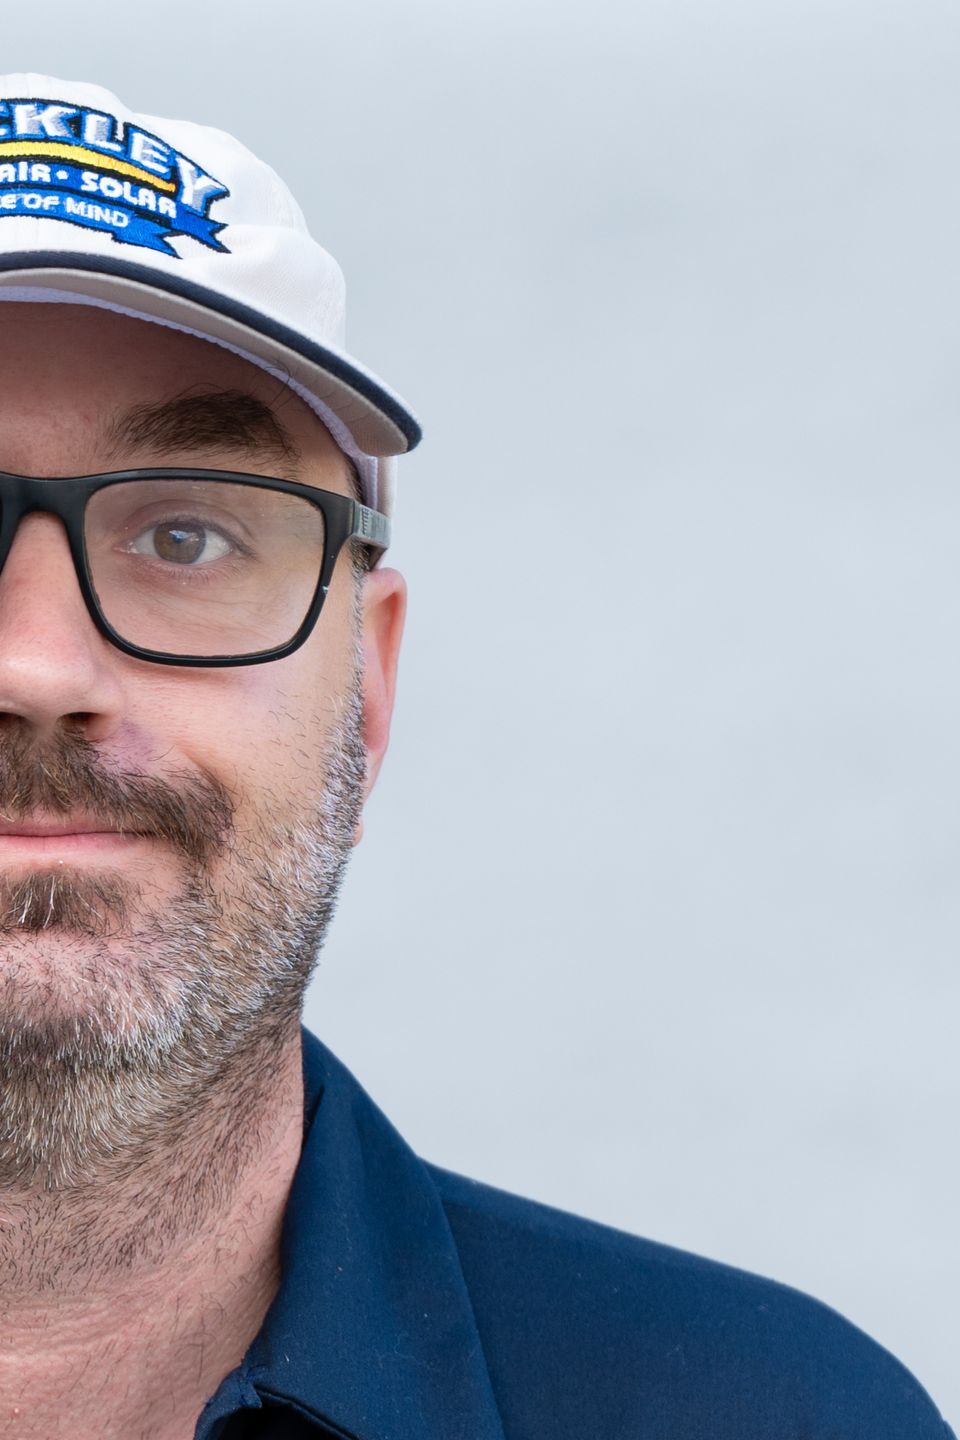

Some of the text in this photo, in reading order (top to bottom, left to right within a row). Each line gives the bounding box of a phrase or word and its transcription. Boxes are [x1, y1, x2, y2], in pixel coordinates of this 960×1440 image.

[22, 194, 59, 211] OF
[65, 196, 130, 229] MIND
[80, 170, 177, 219] SOLAR
